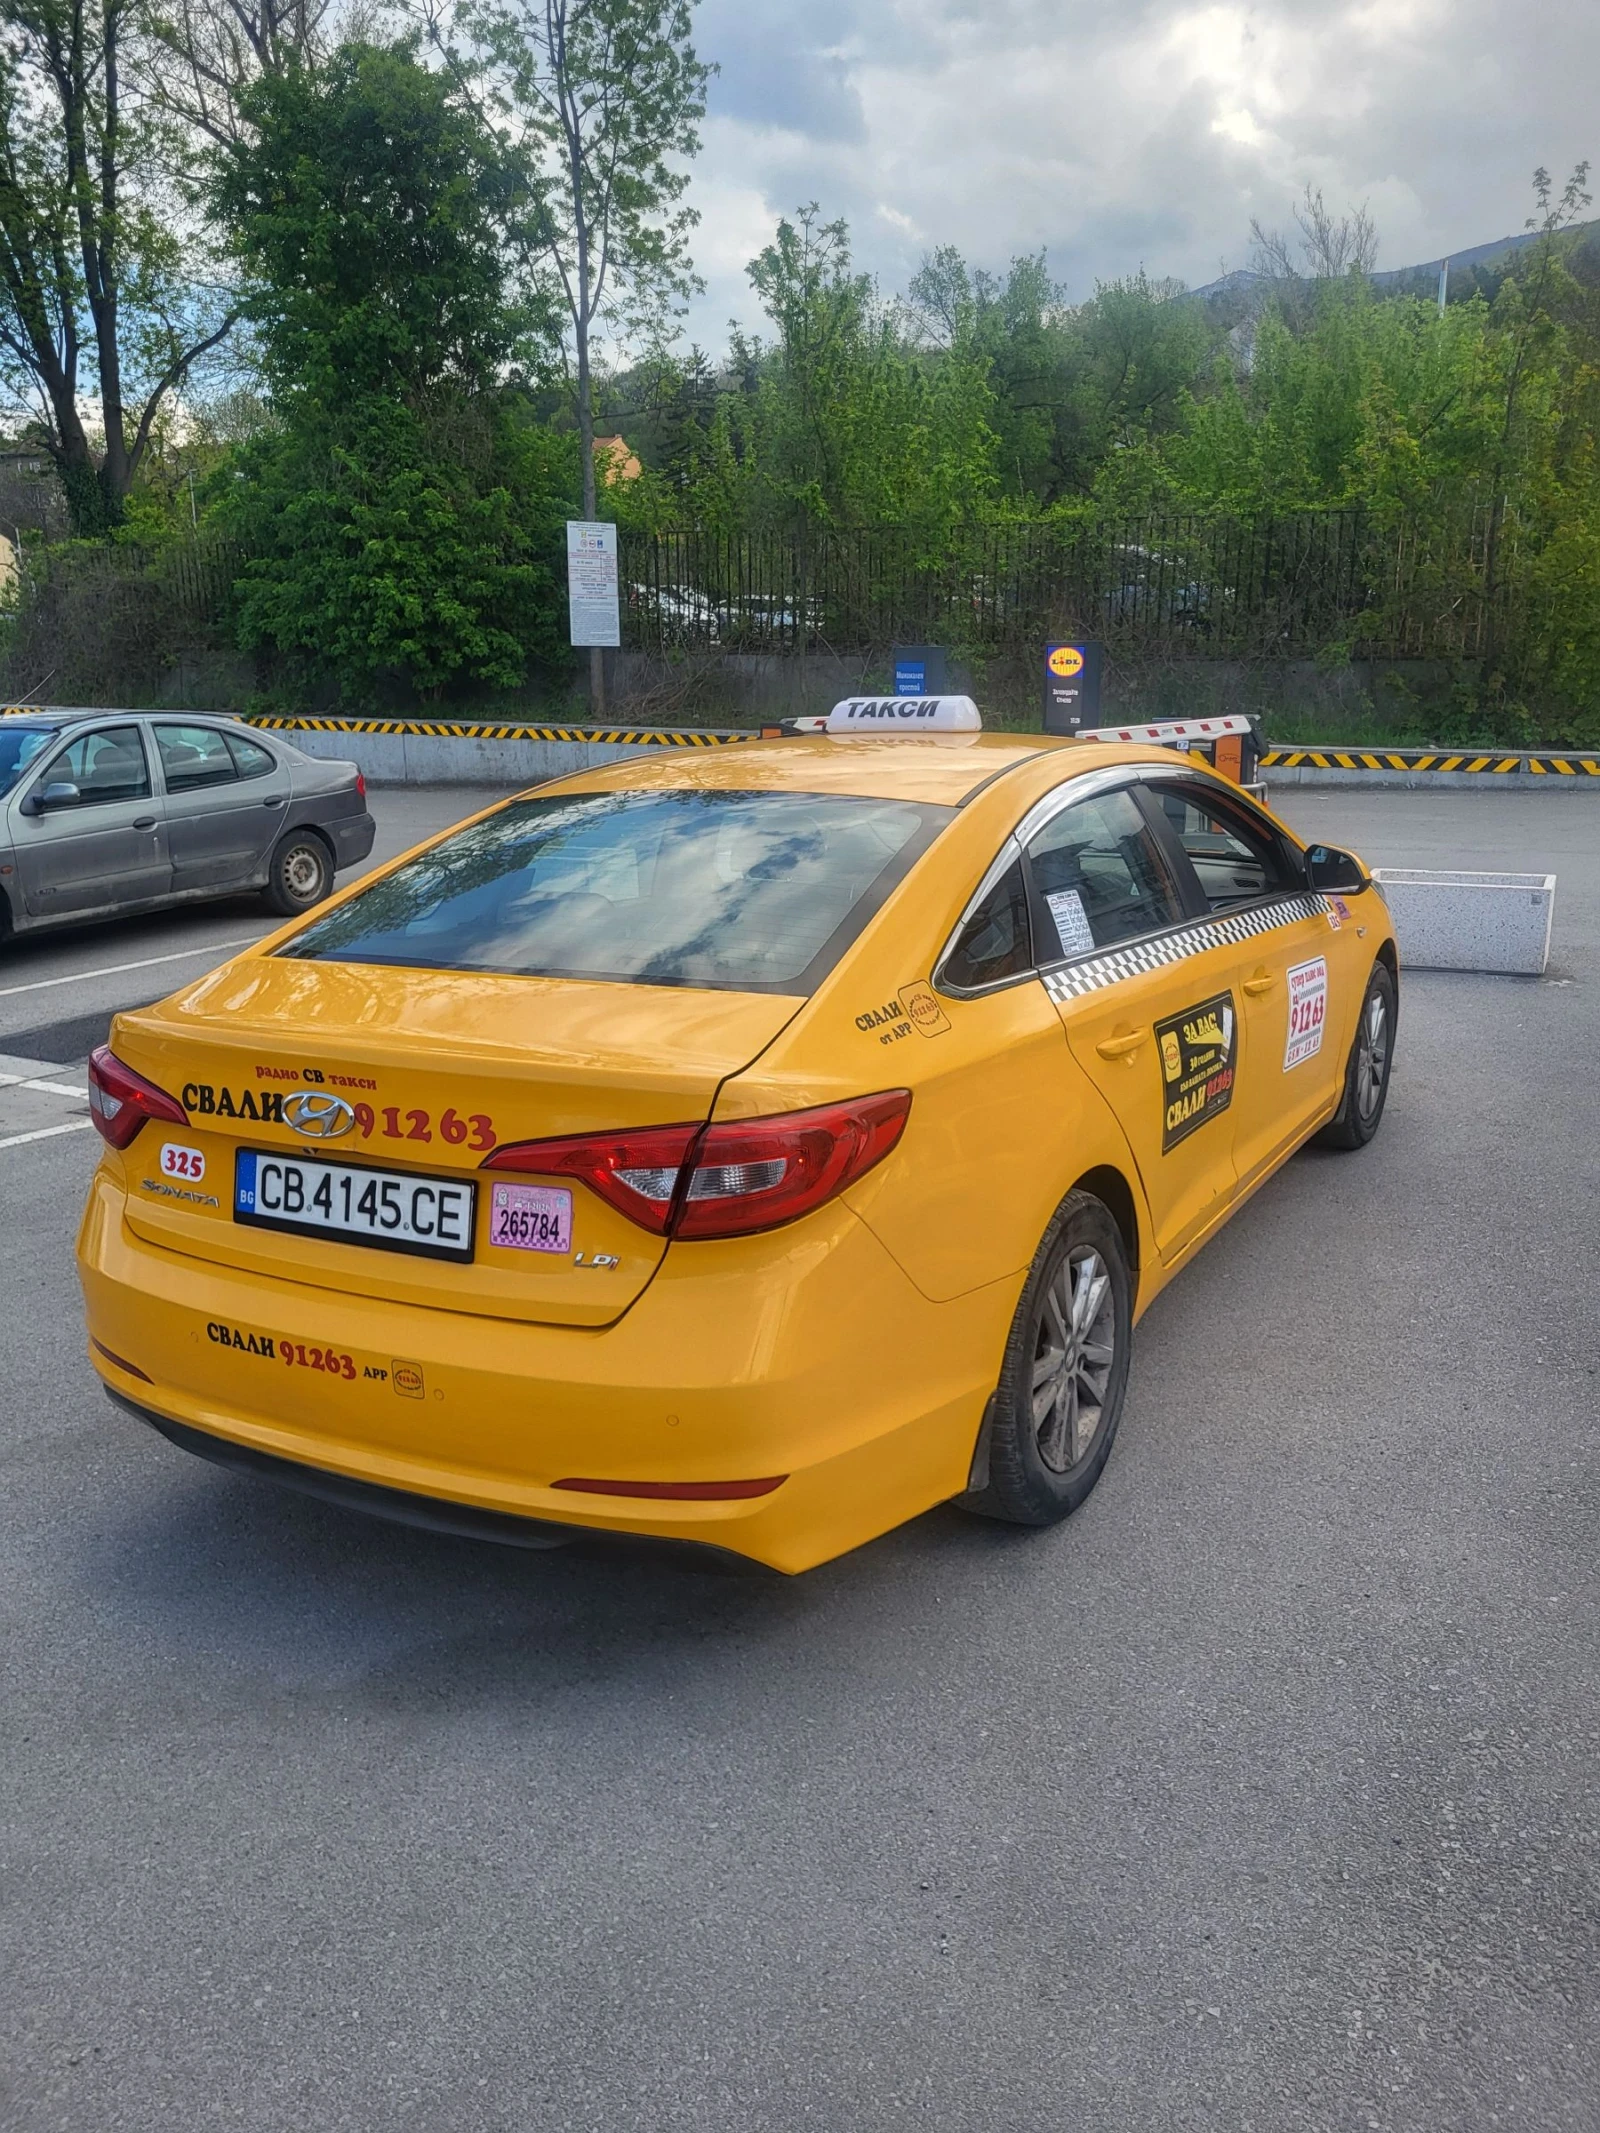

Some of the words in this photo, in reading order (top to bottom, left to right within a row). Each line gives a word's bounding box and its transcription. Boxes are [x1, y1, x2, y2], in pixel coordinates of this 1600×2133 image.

[847, 700, 941, 718] ТАКСИ
[854, 1001, 903, 1032] СВАЛИ
[1183, 1021, 1198, 1042] ЗА
[1291, 994, 1325, 1038] 91263
[255, 1065, 299, 1081] радио
[302, 1068, 325, 1083] СВ
[328, 1074, 377, 1091] такси
[182, 1082, 285, 1124] СВАЛИ
[1166, 1083, 1207, 1132] СВАЛИ
[353, 1102, 498, 1152] 91263
[164, 1149, 203, 1178] 325
[140, 1177, 220, 1209] SONATA
[240, 1189, 255, 1205] BG
[499, 1209, 560, 1242] 265784
[206, 1321, 276, 1359] СВАЛИ
[279, 1340, 357, 1381] 91263
